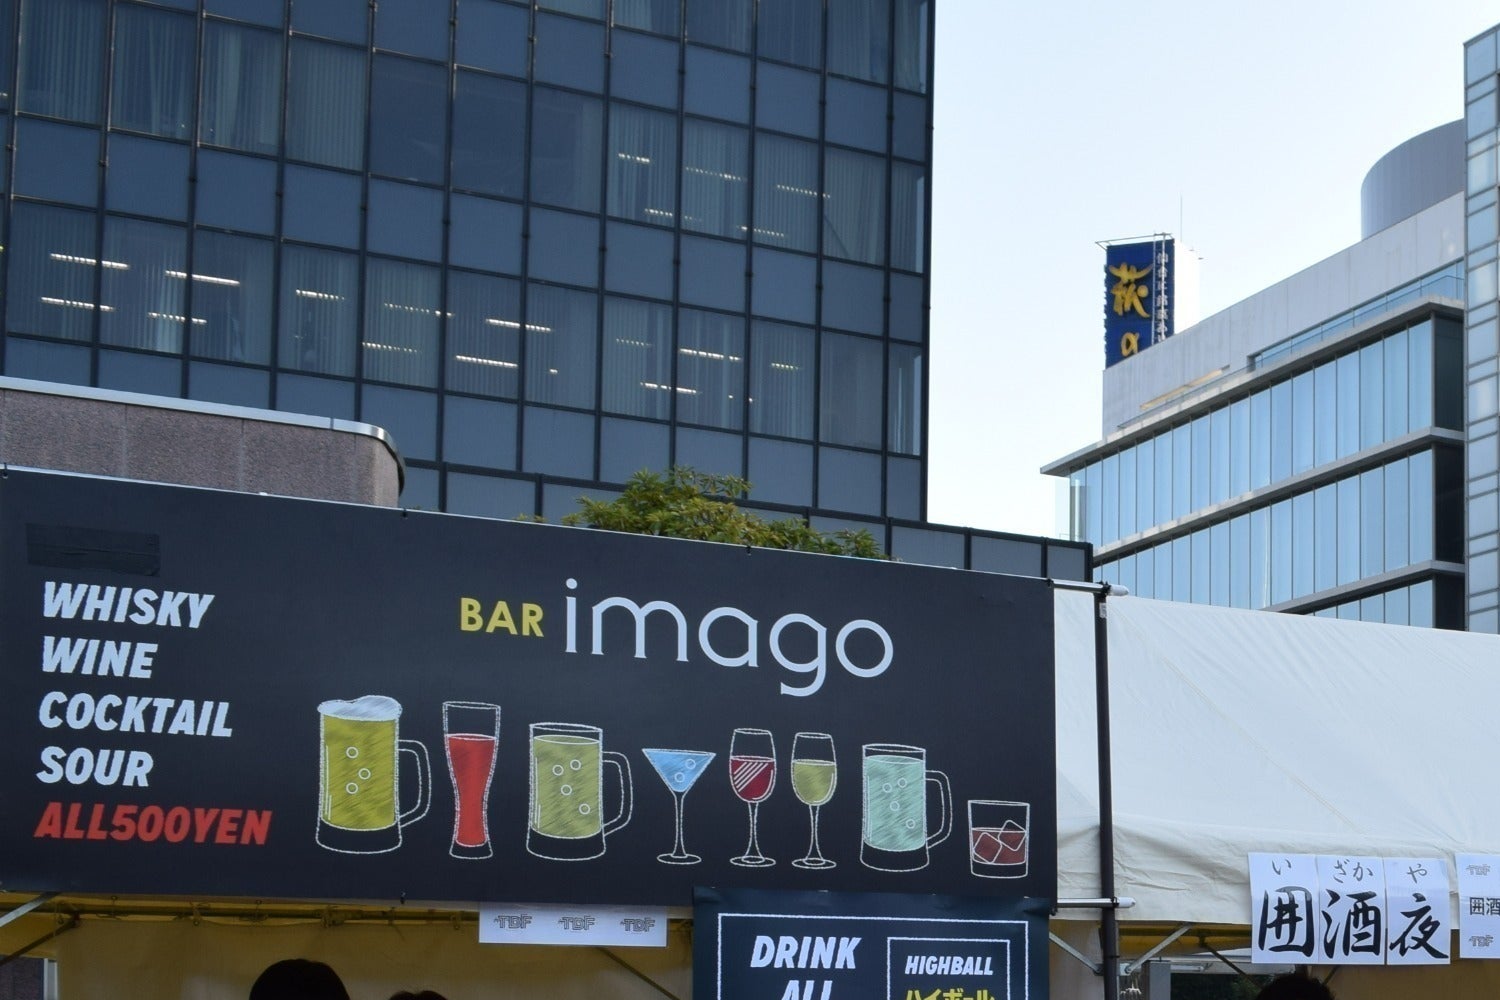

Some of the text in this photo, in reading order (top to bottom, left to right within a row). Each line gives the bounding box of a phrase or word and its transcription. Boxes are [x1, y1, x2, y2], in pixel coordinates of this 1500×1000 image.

[41, 581, 214, 628] WHISKY
[40, 637, 158, 679] WINE
[460, 579, 894, 696] BAR imago
[38, 692, 234, 738] COCKTAIL
[36, 746, 155, 787] SOUR
[33, 802, 272, 846] ALL500YEN
[750, 936, 861, 969] DRINK
[905, 956, 994, 975] HIGHBALL
